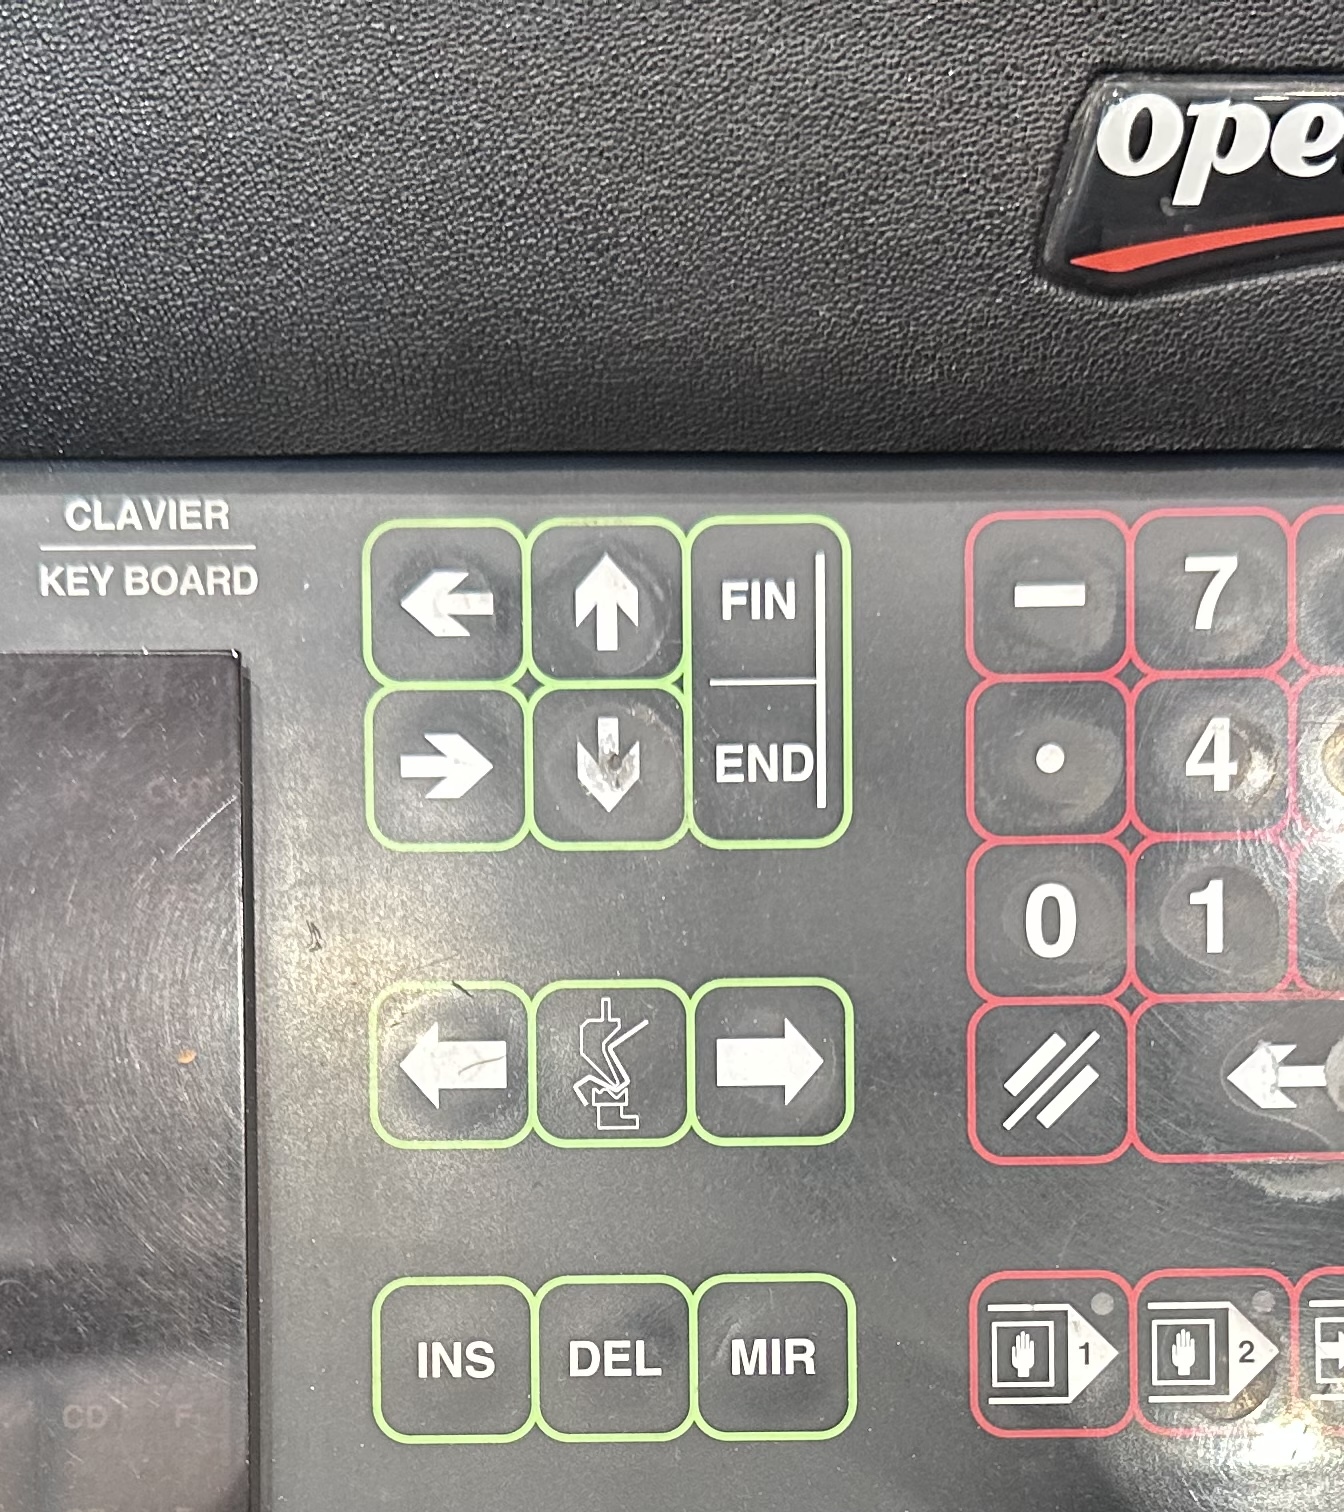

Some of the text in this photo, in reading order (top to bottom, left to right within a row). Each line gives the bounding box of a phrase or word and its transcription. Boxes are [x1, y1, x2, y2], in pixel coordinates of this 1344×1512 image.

[65, 498, 230, 531] CLAVIER
[39, 564, 259, 597] KEY BOARD
[721, 578, 796, 621] FIN
[1184, 554, 1238, 630] 7
[715, 743, 814, 783] END
[1185, 717, 1238, 792] 4
[1024, 882, 1077, 958] 0
[1188, 879, 1224, 954] 1
[418, 1340, 496, 1379] INS
[569, 1339, 663, 1377] DEL
[731, 1338, 816, 1376] MIR
[1078, 1342, 1092, 1366] 1
[1238, 1340, 1255, 1364] 2
[62, 1404, 108, 1430] CD
